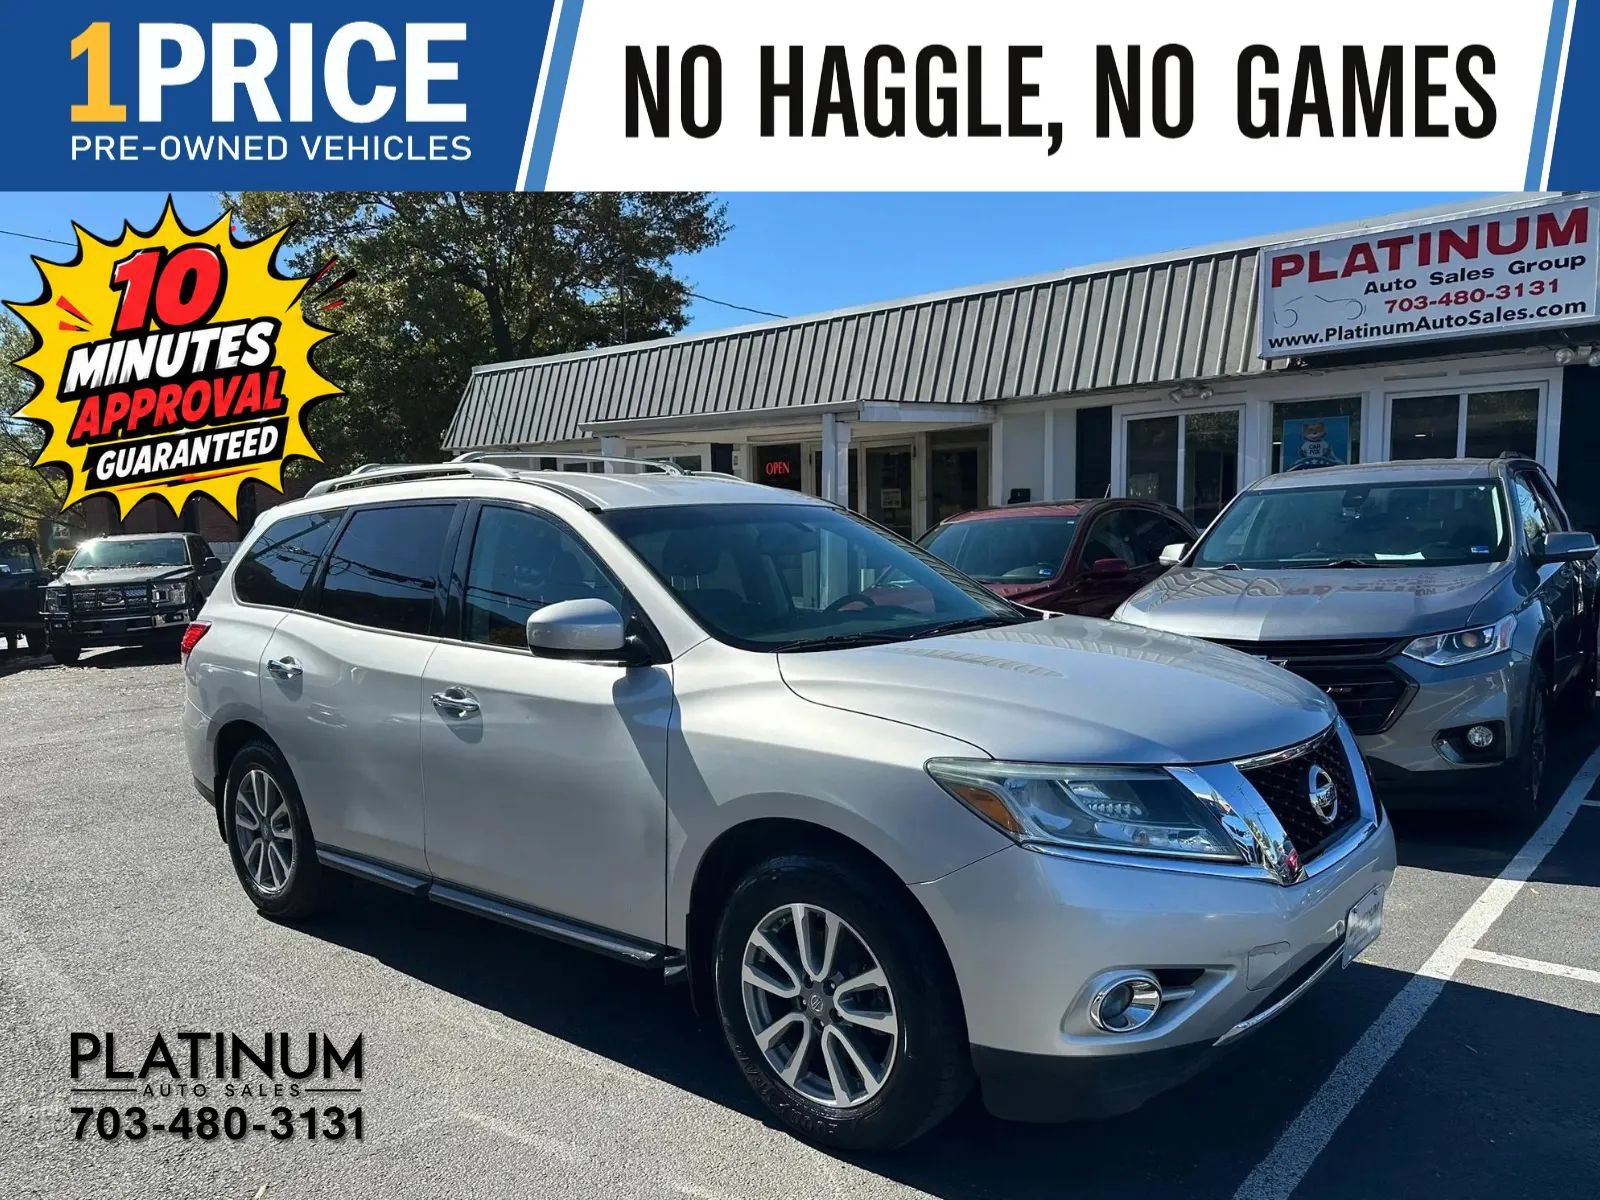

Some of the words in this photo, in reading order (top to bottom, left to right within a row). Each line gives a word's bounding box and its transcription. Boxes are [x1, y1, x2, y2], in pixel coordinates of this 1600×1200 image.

[1271, 207, 1589, 288] PLATINUM
[1364, 277, 1417, 295] Auto
[1429, 265, 1495, 286] Sales
[1508, 255, 1586, 275] Group
[1384, 278, 1559, 314] 703-480-3131
[1268, 300, 1587, 349] www.PlatinumAutoSales.com
[766, 461, 790, 476] OPEN
